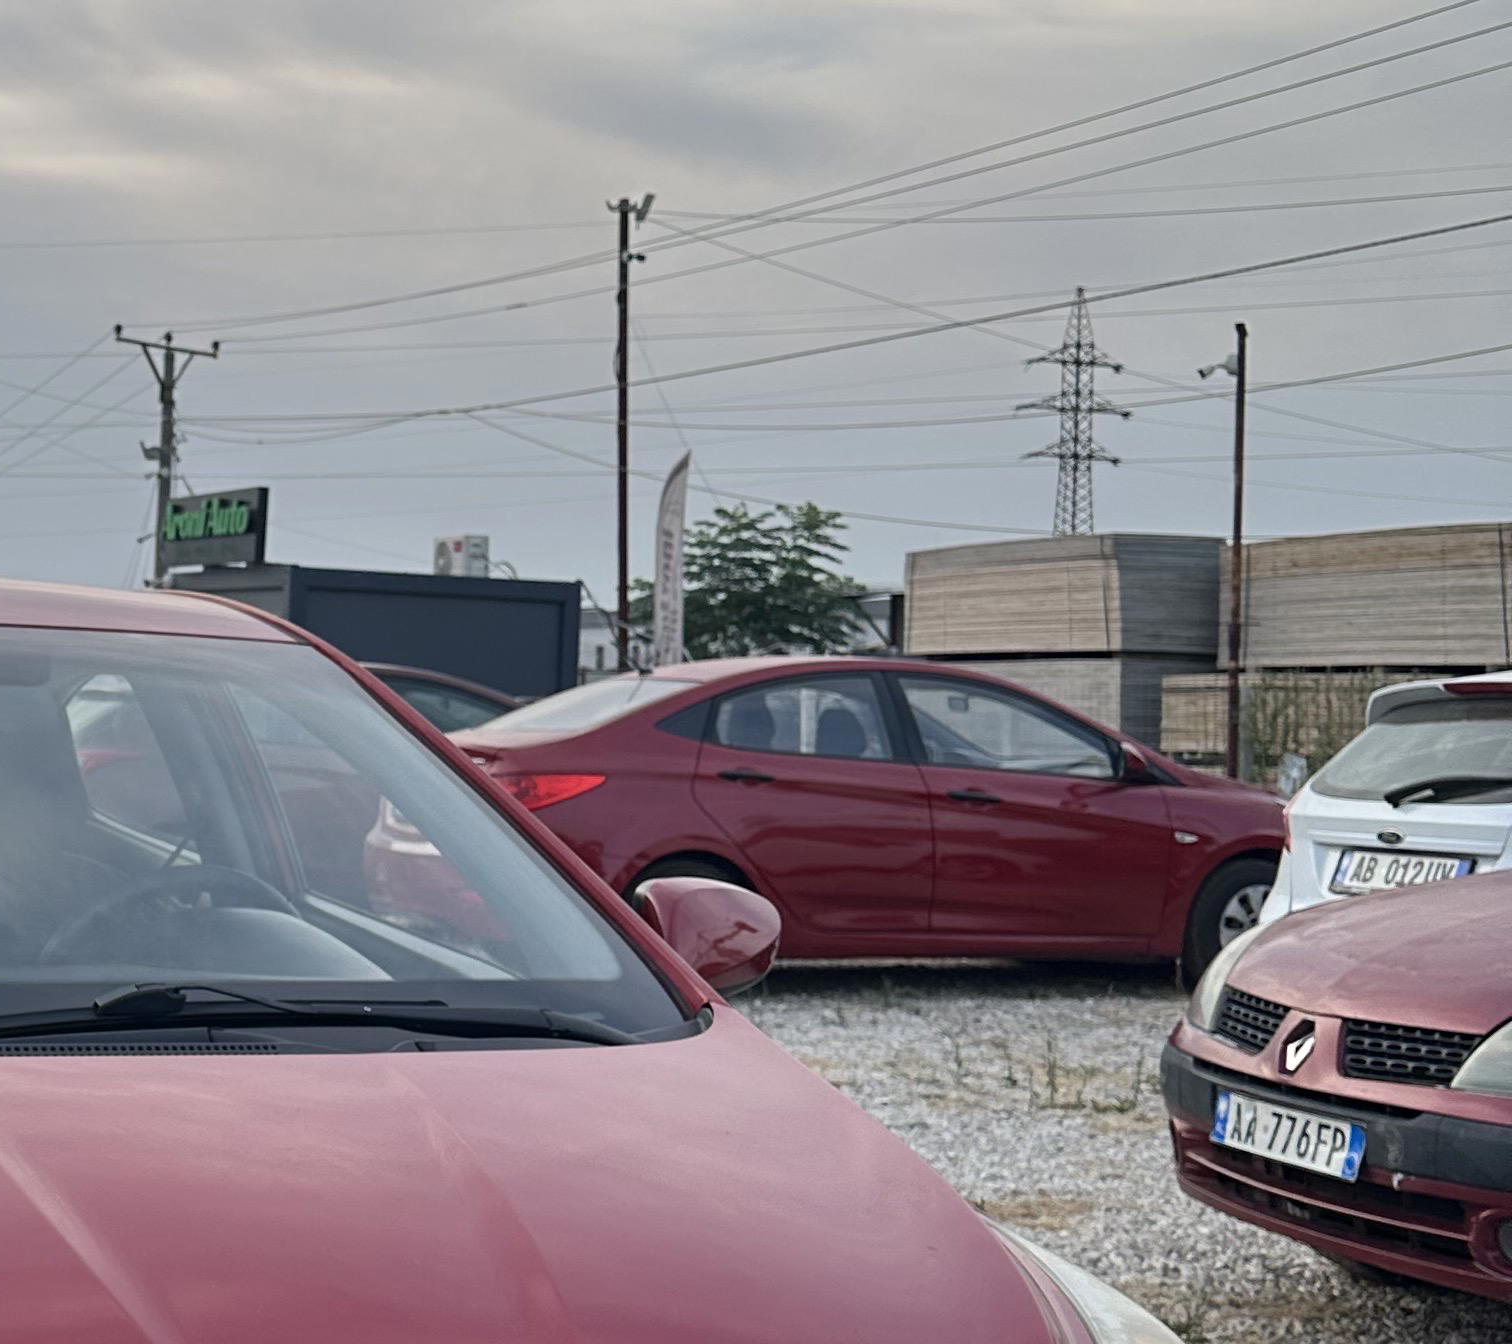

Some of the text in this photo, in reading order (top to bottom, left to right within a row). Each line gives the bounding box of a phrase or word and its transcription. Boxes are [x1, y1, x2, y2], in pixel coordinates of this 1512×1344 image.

[208, 498, 249, 536] Auto
[1349, 856, 1378, 883] AB
[1230, 1103, 1346, 1167] AA 776FP
